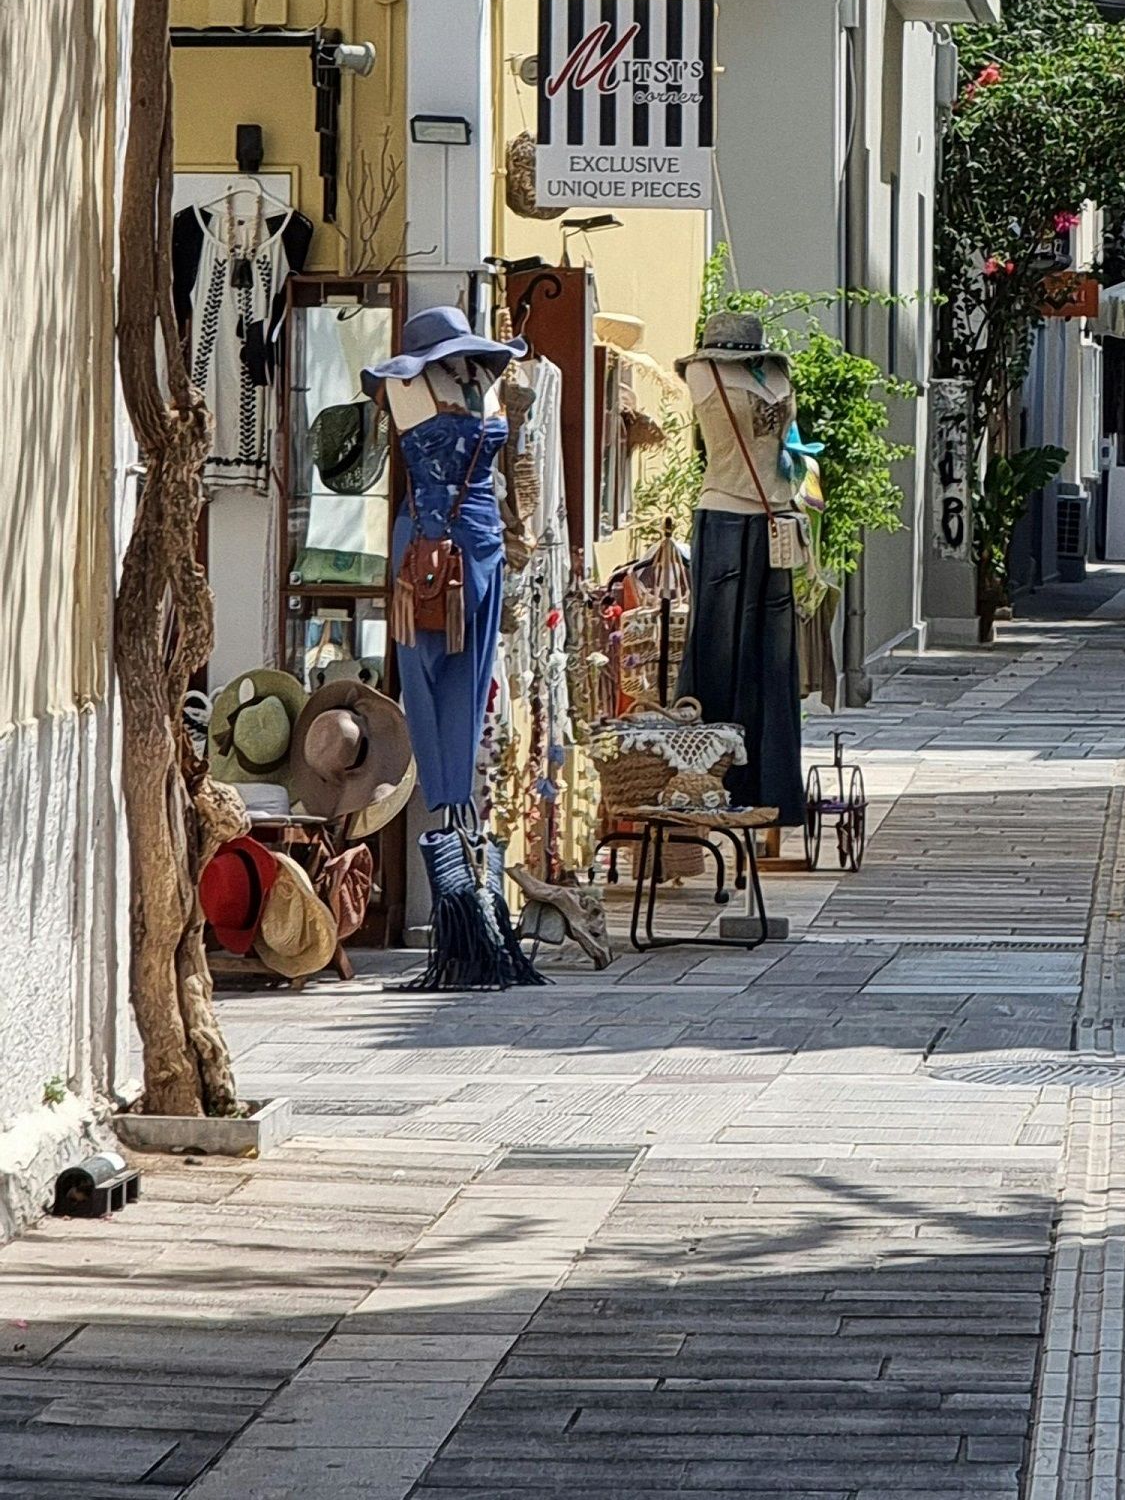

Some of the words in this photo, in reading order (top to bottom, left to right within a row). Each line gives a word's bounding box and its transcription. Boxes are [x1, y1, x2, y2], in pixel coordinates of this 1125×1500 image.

[546, 22, 704, 97] MITSI'S
[633, 90, 703, 105] corner
[569, 155, 681, 173] EXCLUSIVE
[547, 180, 626, 199] UNIQUE
[630, 181, 702, 199] PIECES
